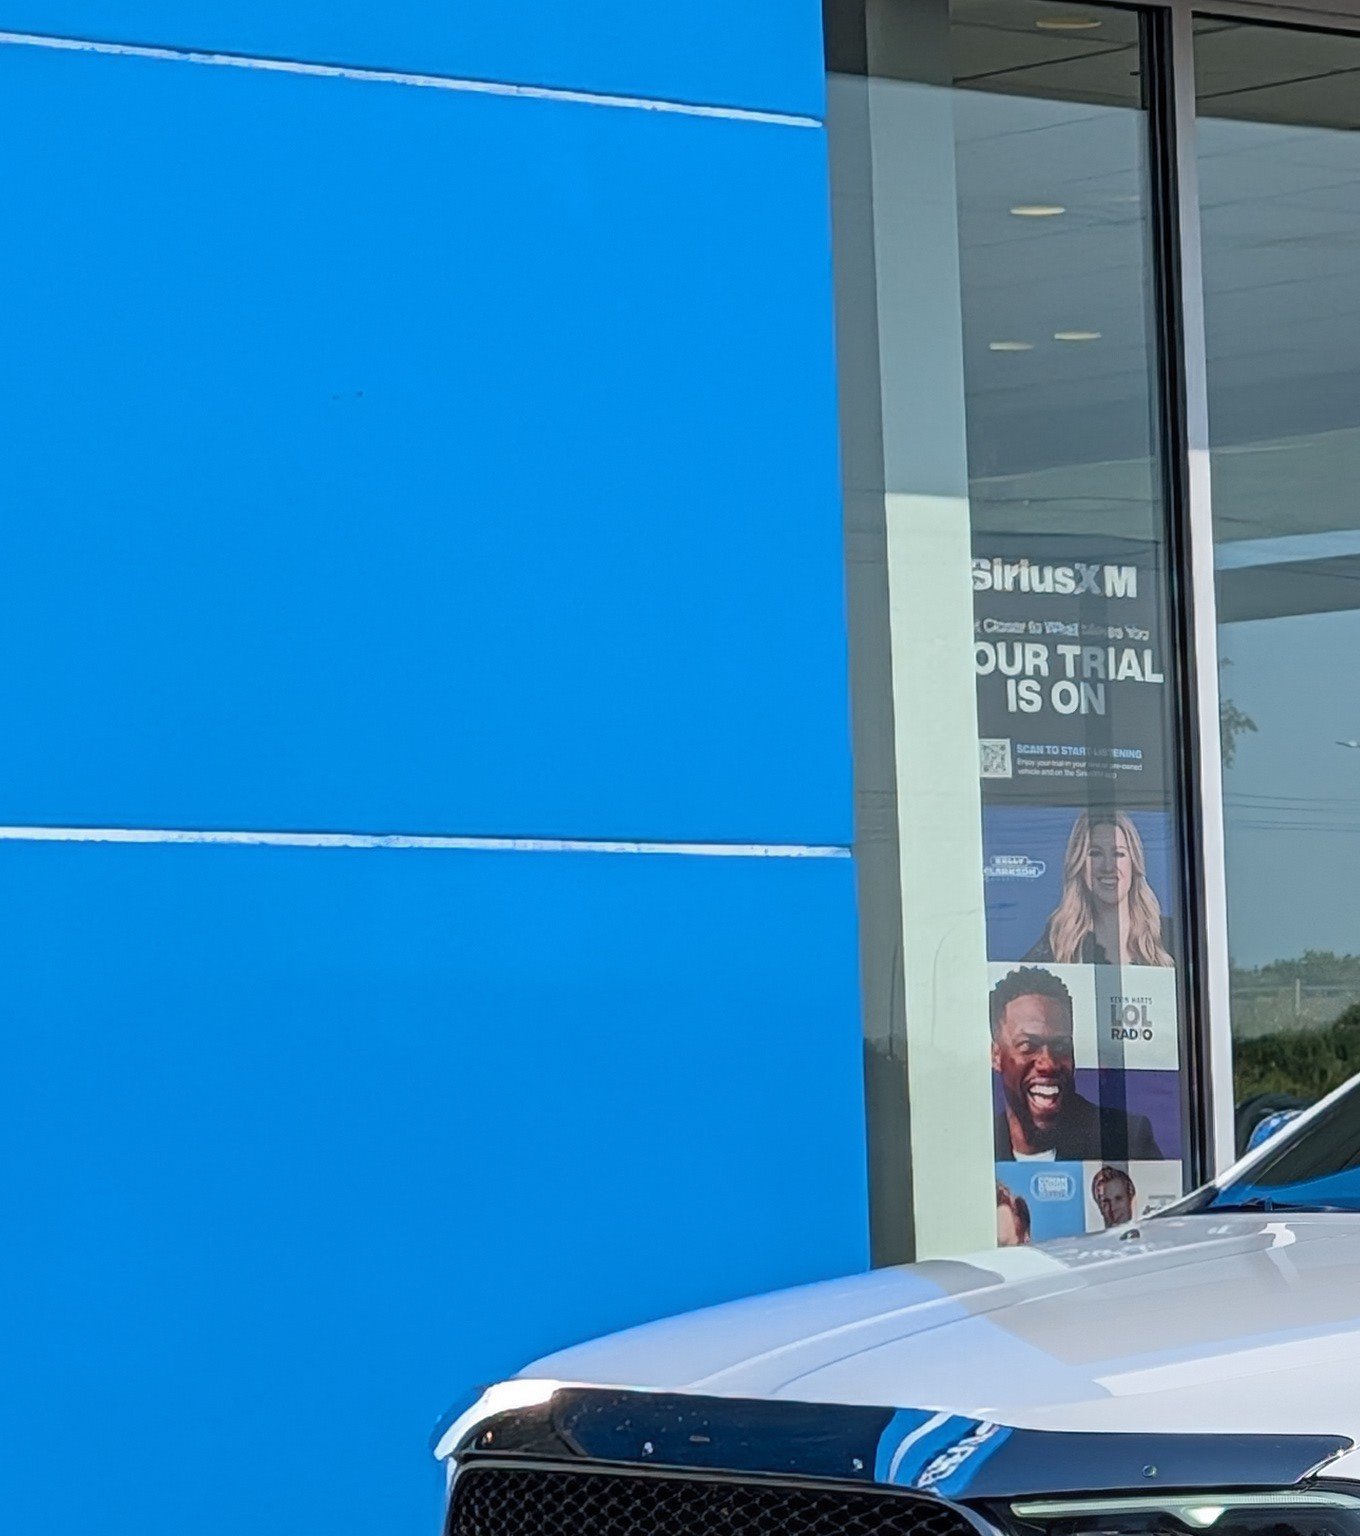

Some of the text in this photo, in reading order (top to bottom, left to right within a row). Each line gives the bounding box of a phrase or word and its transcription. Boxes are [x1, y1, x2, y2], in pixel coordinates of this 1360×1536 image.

[972, 558, 1137, 598] SiriusXM
[1057, 645, 1164, 683] TRIAL
[1007, 679, 1106, 715] IS ON
[1016, 744, 1044, 755] SCAN
[1044, 745, 1060, 755] TO
[1110, 1004, 1153, 1028] LOL
[1111, 1028, 1153, 1041] RADIO
